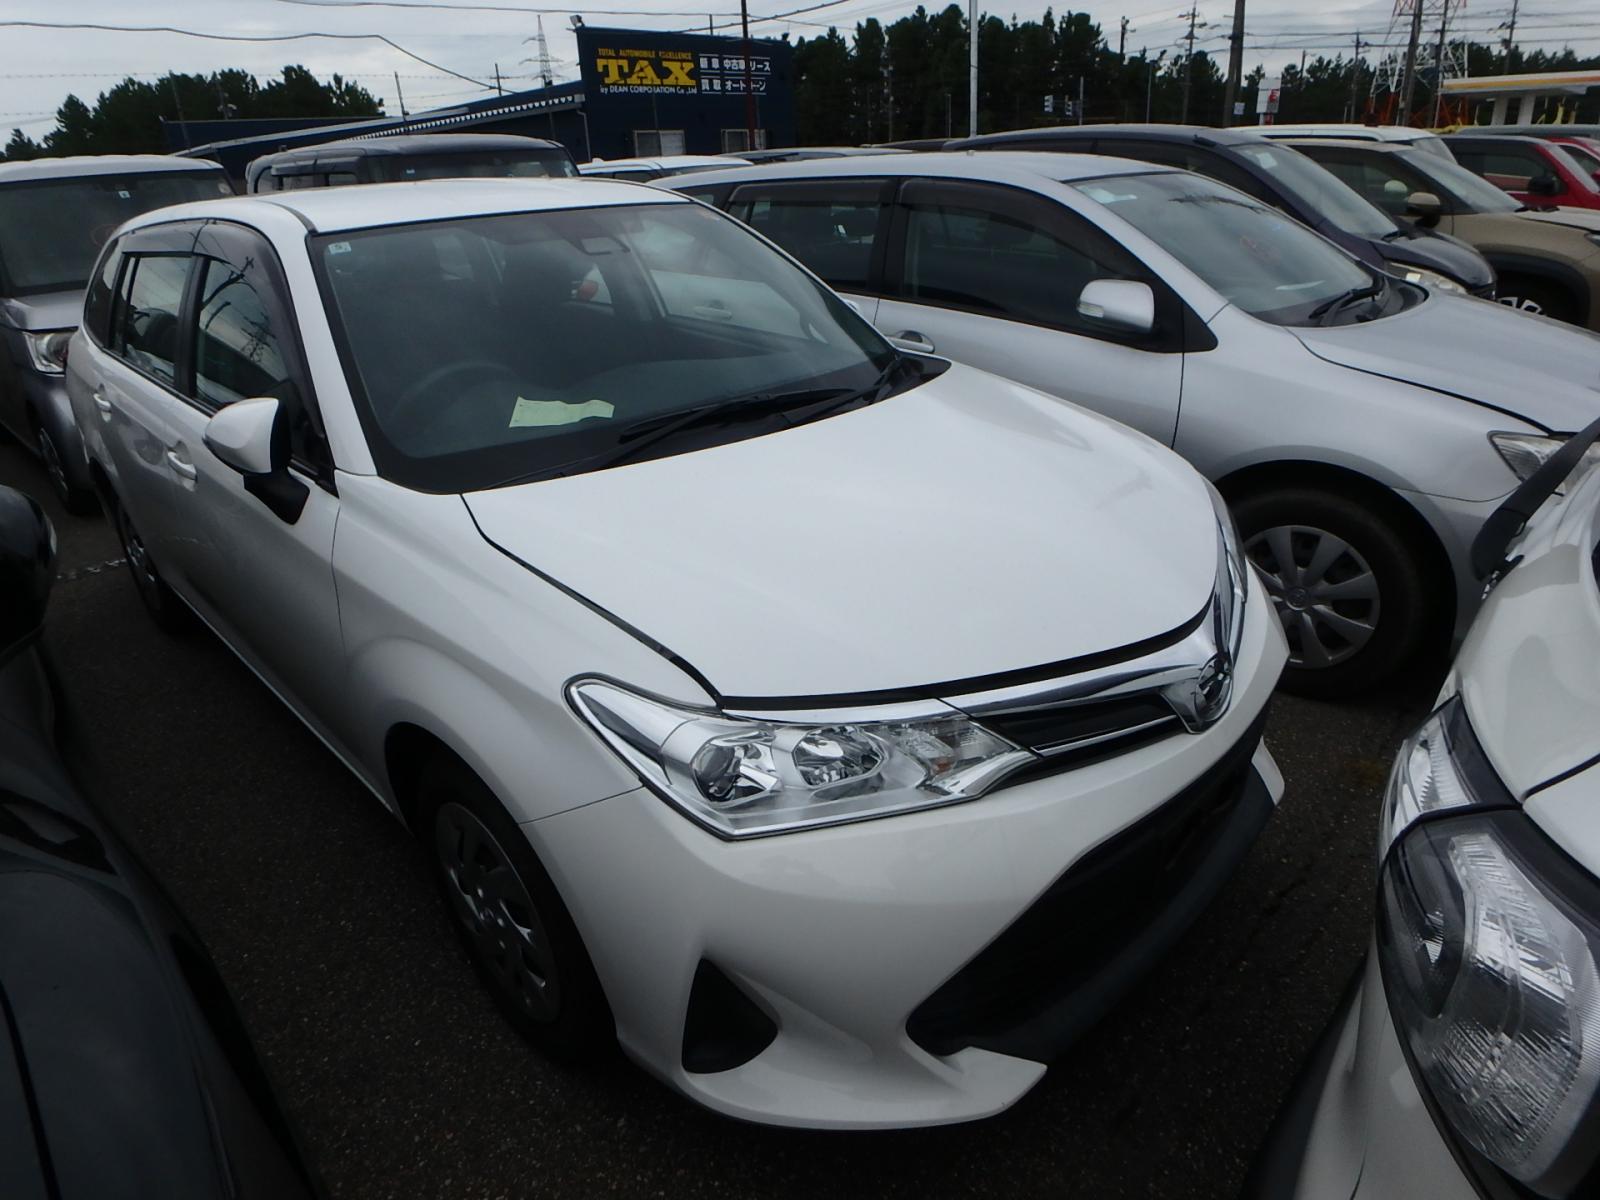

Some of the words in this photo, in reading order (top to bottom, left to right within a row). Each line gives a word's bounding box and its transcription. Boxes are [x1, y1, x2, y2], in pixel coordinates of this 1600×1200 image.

[598, 48, 615, 56] TOTAL
[620, 49, 655, 58] AUTOMOBILE
[723, 59, 746, 70] 中古車
[749, 61, 770, 71] リース
[597, 59, 696, 86] TAX
[725, 80, 766, 91] オートーン
